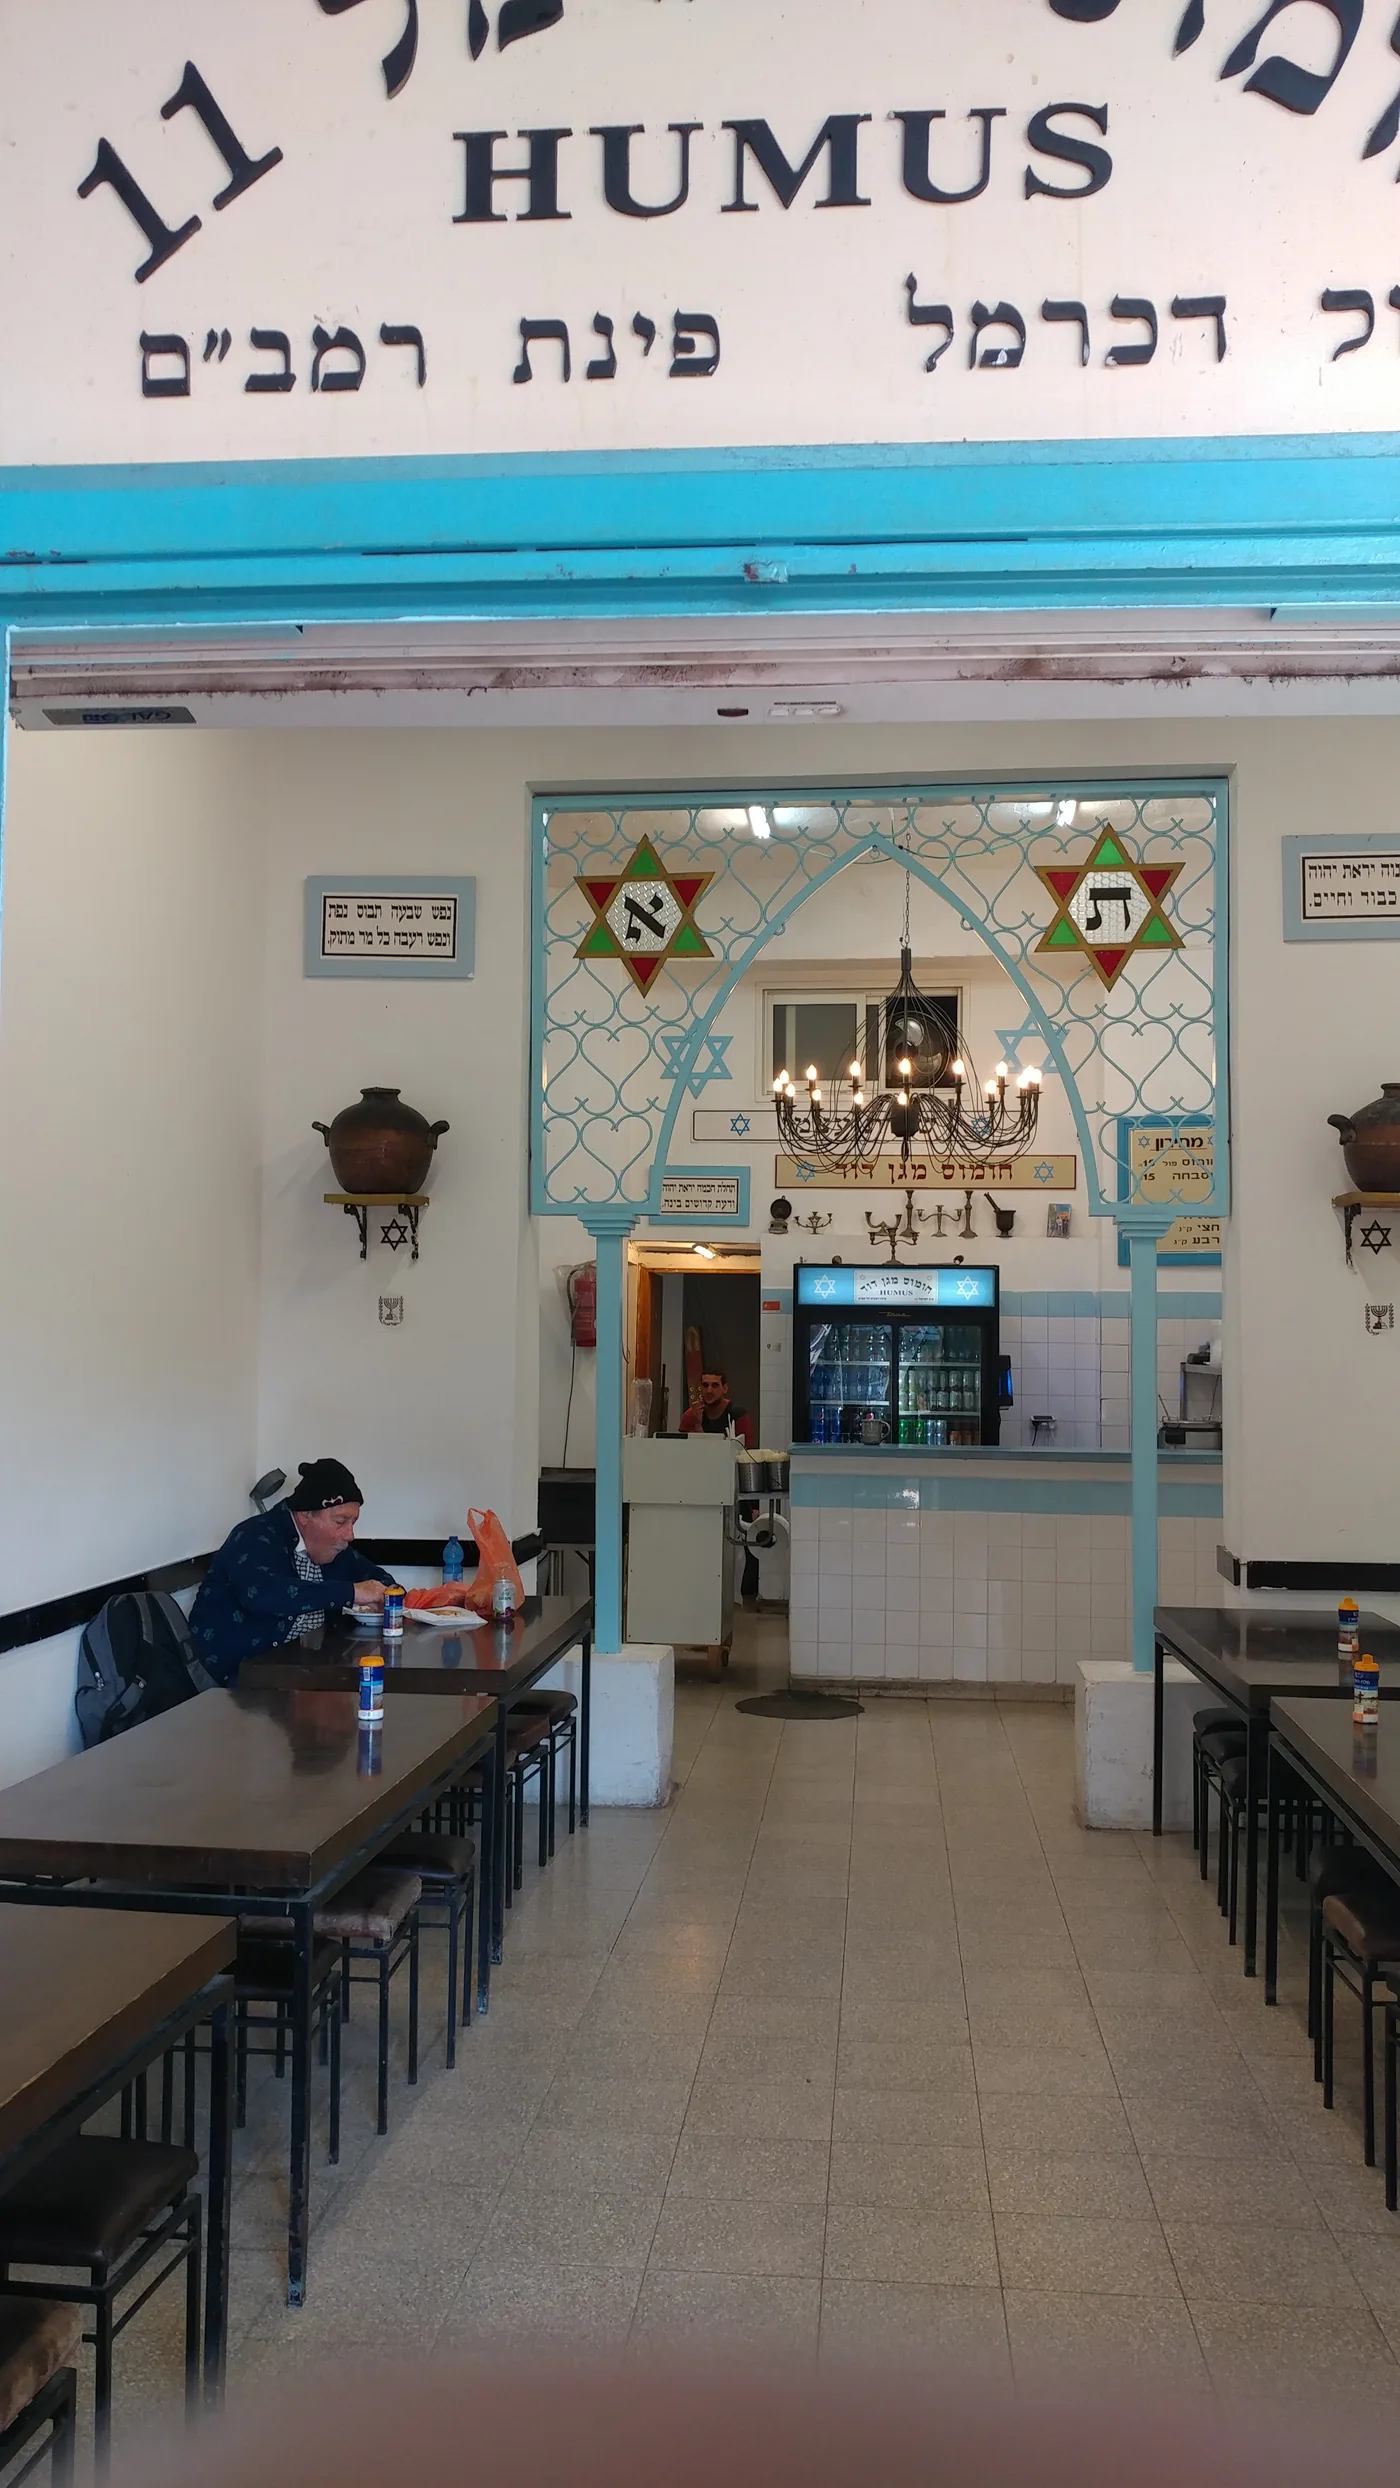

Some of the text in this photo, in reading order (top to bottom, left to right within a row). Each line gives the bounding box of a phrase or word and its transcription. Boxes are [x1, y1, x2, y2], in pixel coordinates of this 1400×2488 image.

[452, 102, 1113, 223] HUMUS
[76, 59, 284, 284] 11
[513, 307, 720, 384] פינת
[1308, 864, 1337, 879] יהוה
[1342, 863, 1375, 879] יראת
[328, 903, 452, 923] נפש שבעה תבוס נפת
[624, 892, 667, 943] א
[1085, 887, 1132, 932] ת
[358, 930, 373, 945] מר
[376, 925, 390, 945] כל
[393, 930, 423, 949] רעבה
[427, 931, 451, 946] ונפש
[835, 1163, 1013, 1184] חומוס מגן דוד
[662, 1183, 677, 1192] יהוה
[678, 1183, 695, 1193] יראת
[697, 1183, 716, 1193] חכמה
[685, 1198, 713, 1210] קדושים
[715, 1199, 735, 1210] ודעת
[1198, 1224, 1220, 1232] חצי
[1192, 1236, 1220, 1244] רבע
[860, 1276, 933, 1294] חומוס מגן דוד
